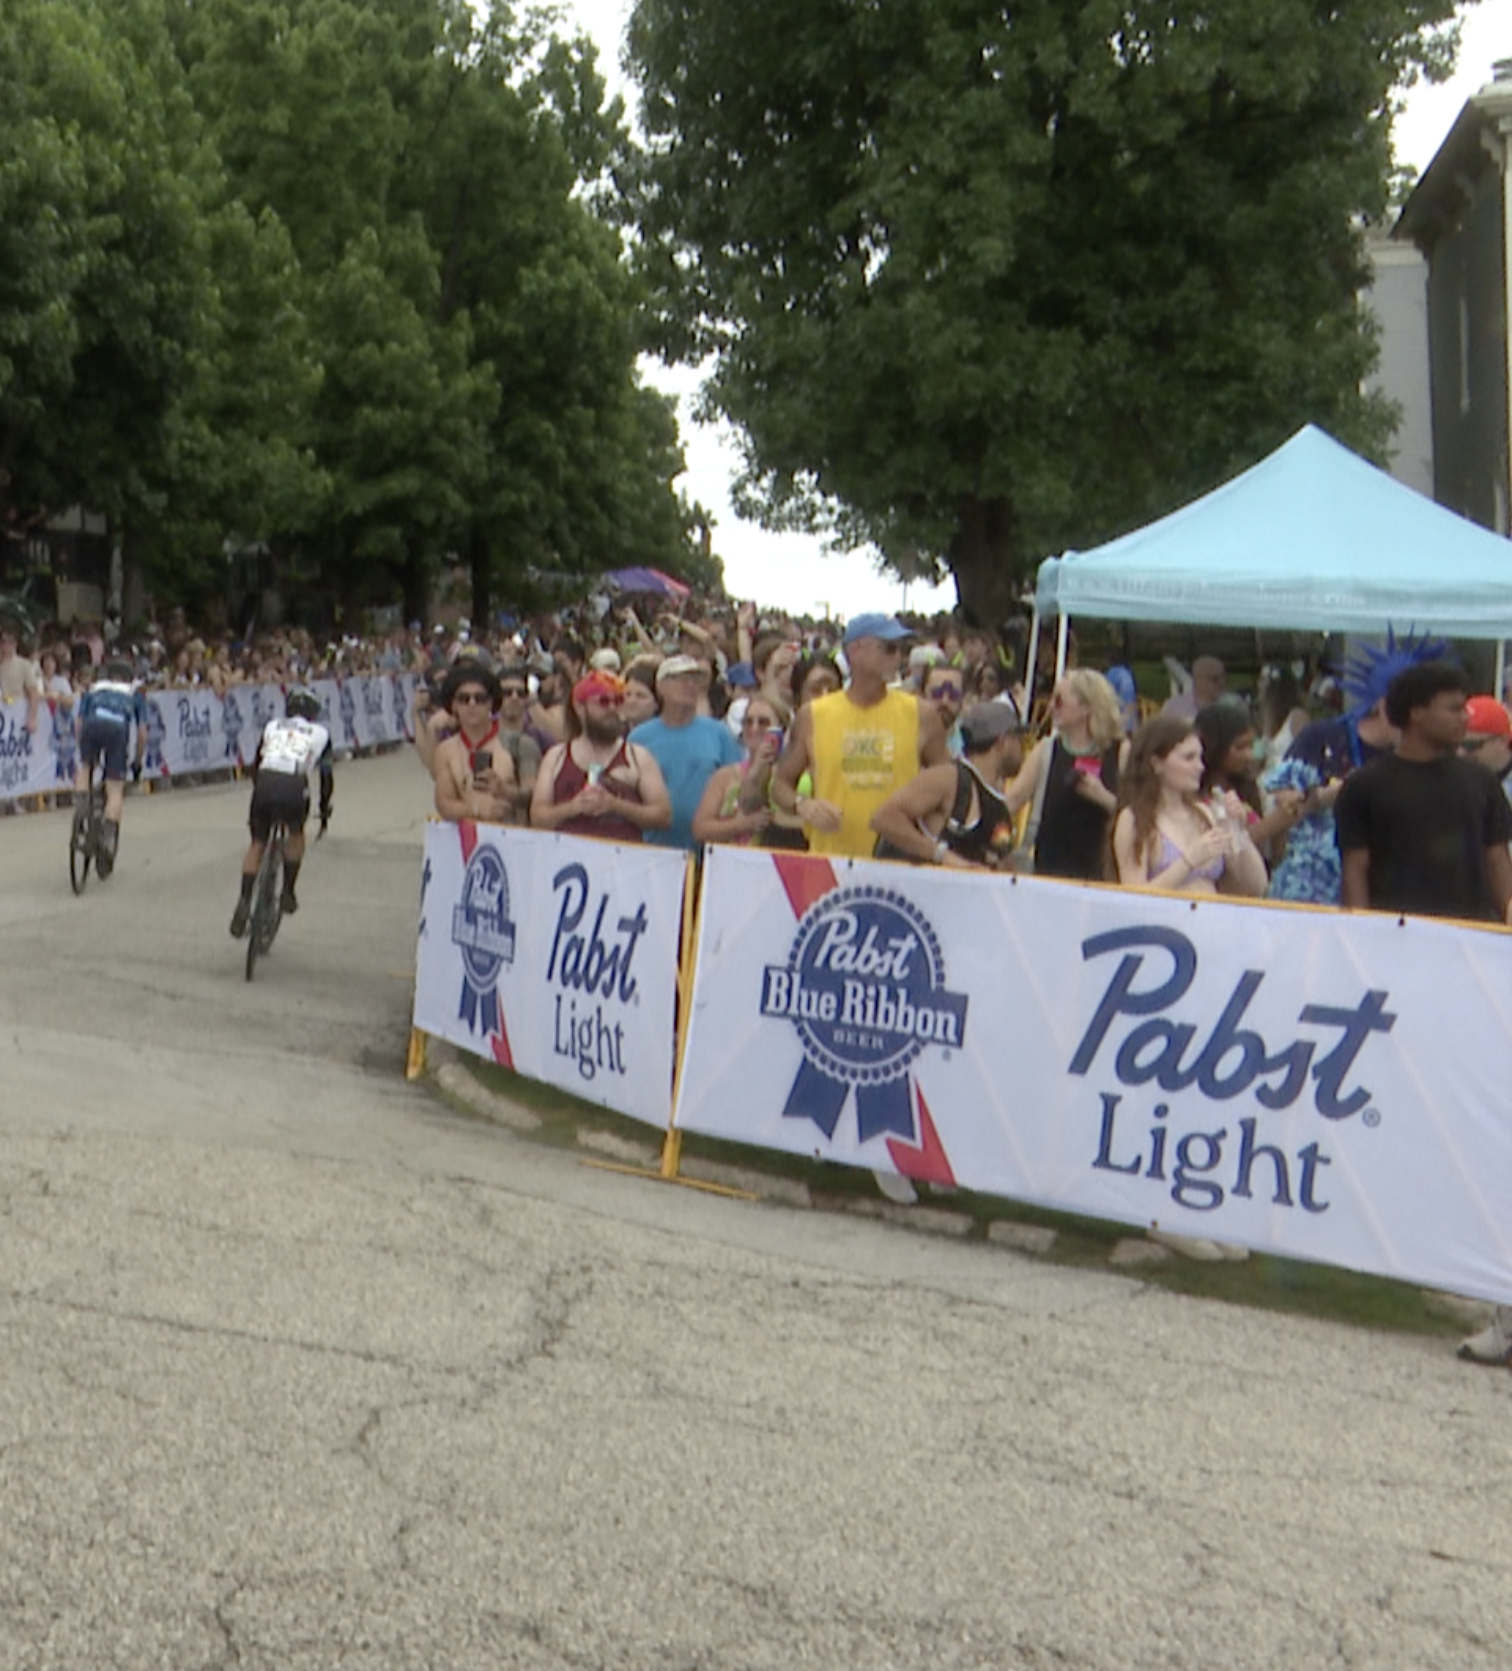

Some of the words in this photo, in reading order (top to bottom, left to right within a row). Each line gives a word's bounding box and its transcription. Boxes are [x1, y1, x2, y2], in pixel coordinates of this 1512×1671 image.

[547, 862, 648, 1003] Pabst
[814, 908, 918, 981] Pabst
[553, 994, 626, 1081] Light
[764, 969, 837, 1022] Blue
[840, 978, 958, 1043] Ribbon
[832, 1029, 885, 1049] BEER
[1067, 924, 1398, 1120] Pabst
[1091, 1091, 1332, 1213] Light
